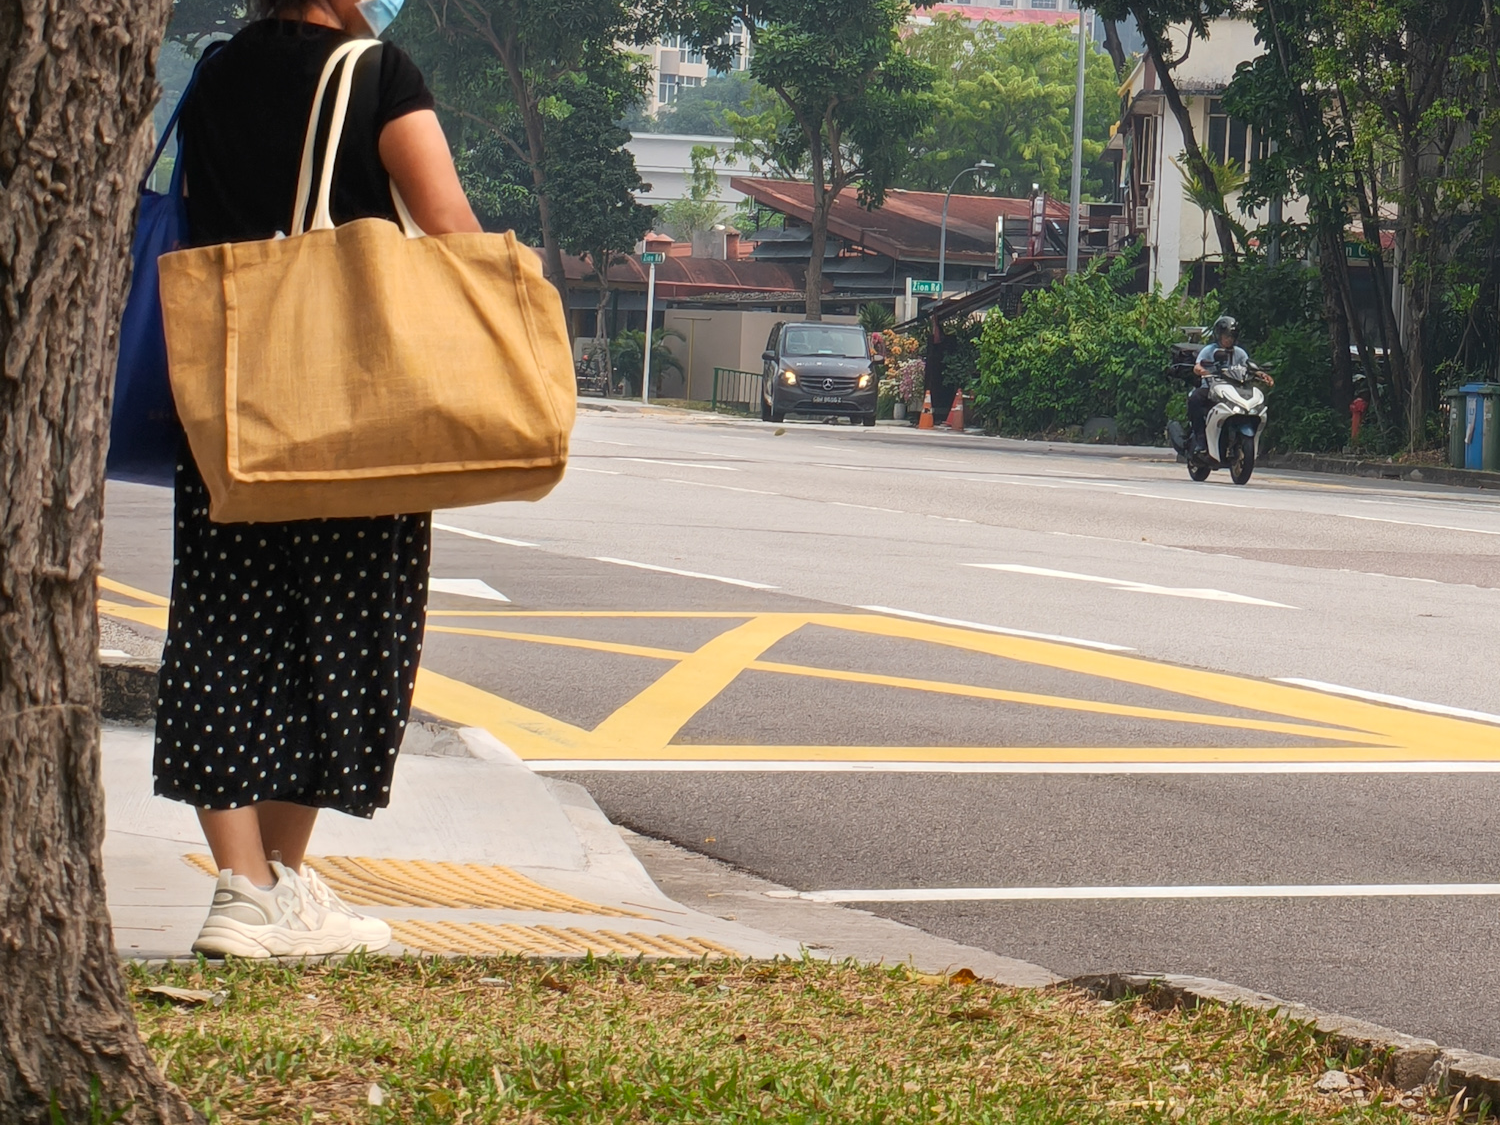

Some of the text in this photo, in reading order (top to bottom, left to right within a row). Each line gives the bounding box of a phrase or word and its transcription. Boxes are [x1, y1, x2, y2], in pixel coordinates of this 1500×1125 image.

[643, 253, 662, 262] Zion Rd
[912, 281, 940, 292] Zion Rd
